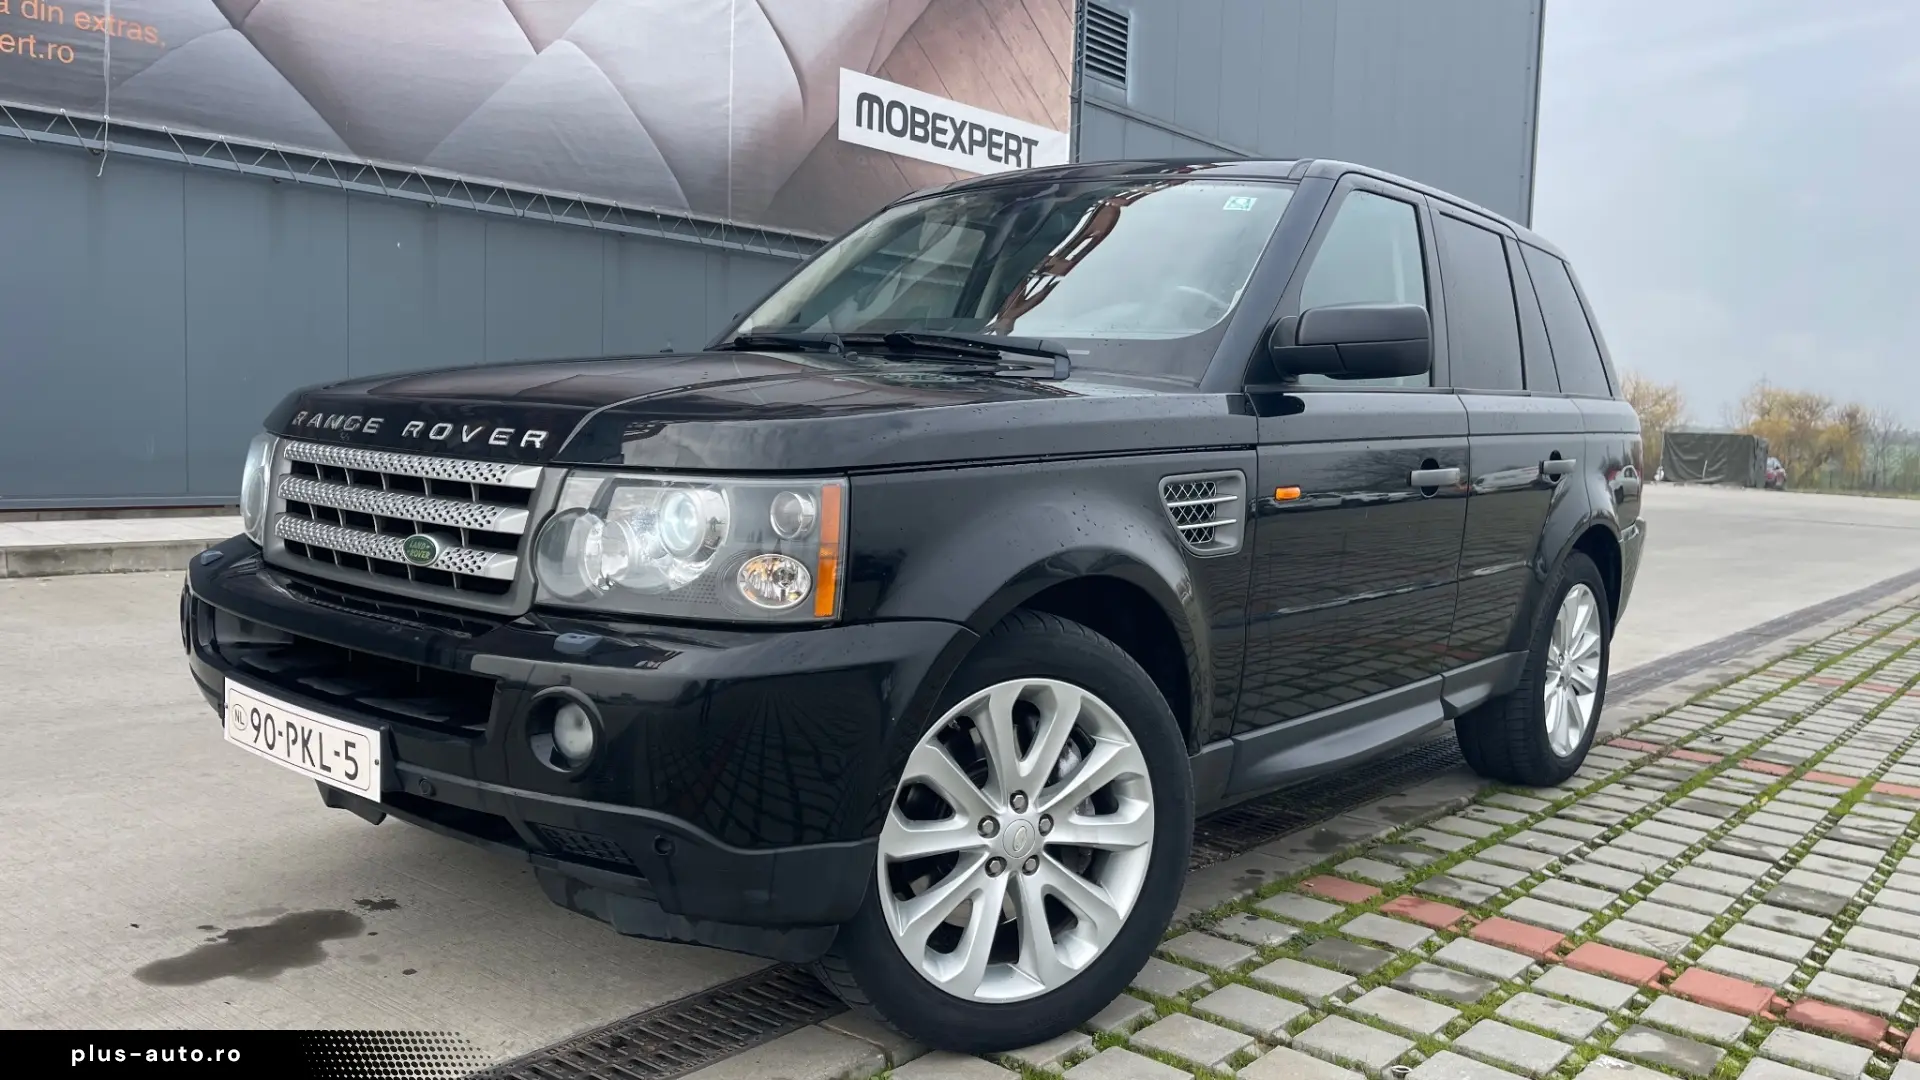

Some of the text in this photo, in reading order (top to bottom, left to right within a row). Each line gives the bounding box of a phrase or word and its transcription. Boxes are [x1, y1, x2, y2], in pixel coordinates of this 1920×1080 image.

[20, 0, 64, 25] din
[856, 92, 1039, 168] MOBEXPERT
[291, 411, 549, 449] RANGE ROVER
[234, 707, 359, 781] NL 90-PKL-5
